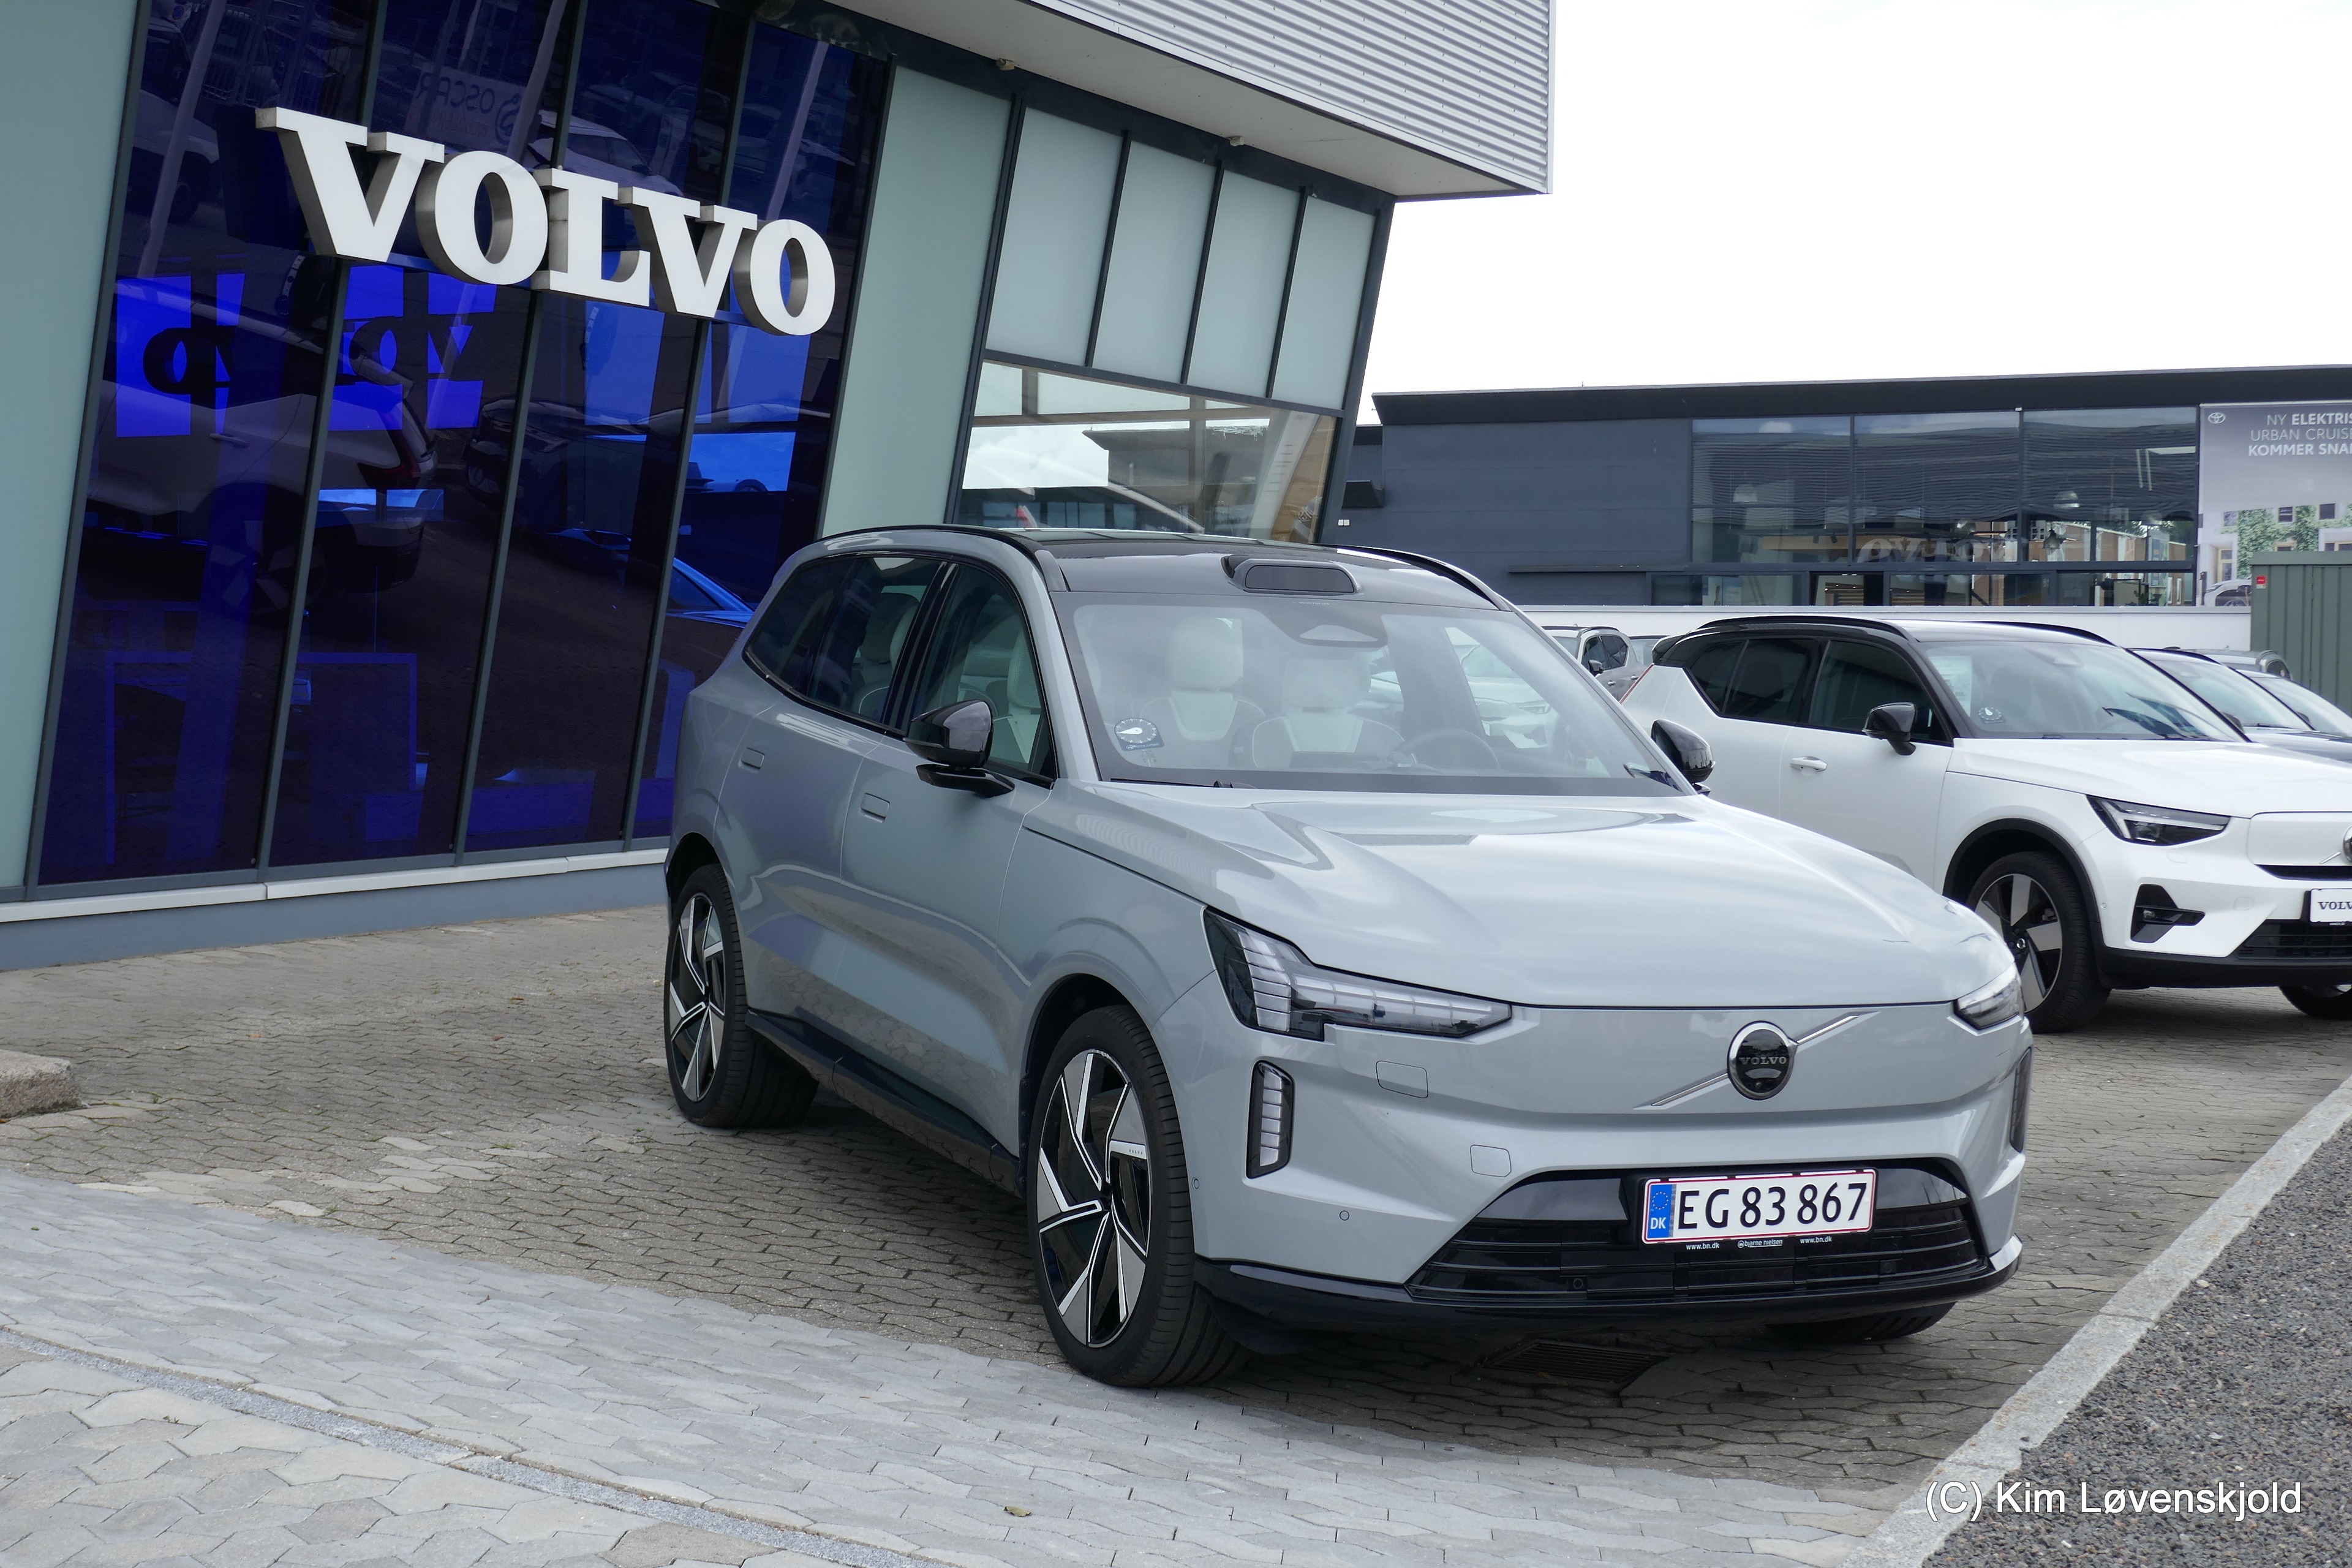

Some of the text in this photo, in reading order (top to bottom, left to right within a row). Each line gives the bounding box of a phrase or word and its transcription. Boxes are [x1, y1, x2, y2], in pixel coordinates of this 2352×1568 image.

[257, 107, 835, 336] VOLVO
[2267, 413, 2287, 426] NY
[2250, 429, 2300, 442] URBAN
[2248, 443, 2352, 456] KOMMER SNA
[1738, 1057, 1787, 1065] VOLVO
[1678, 1182, 1868, 1229] EG 83 867
[1650, 1216, 1666, 1230] DK
